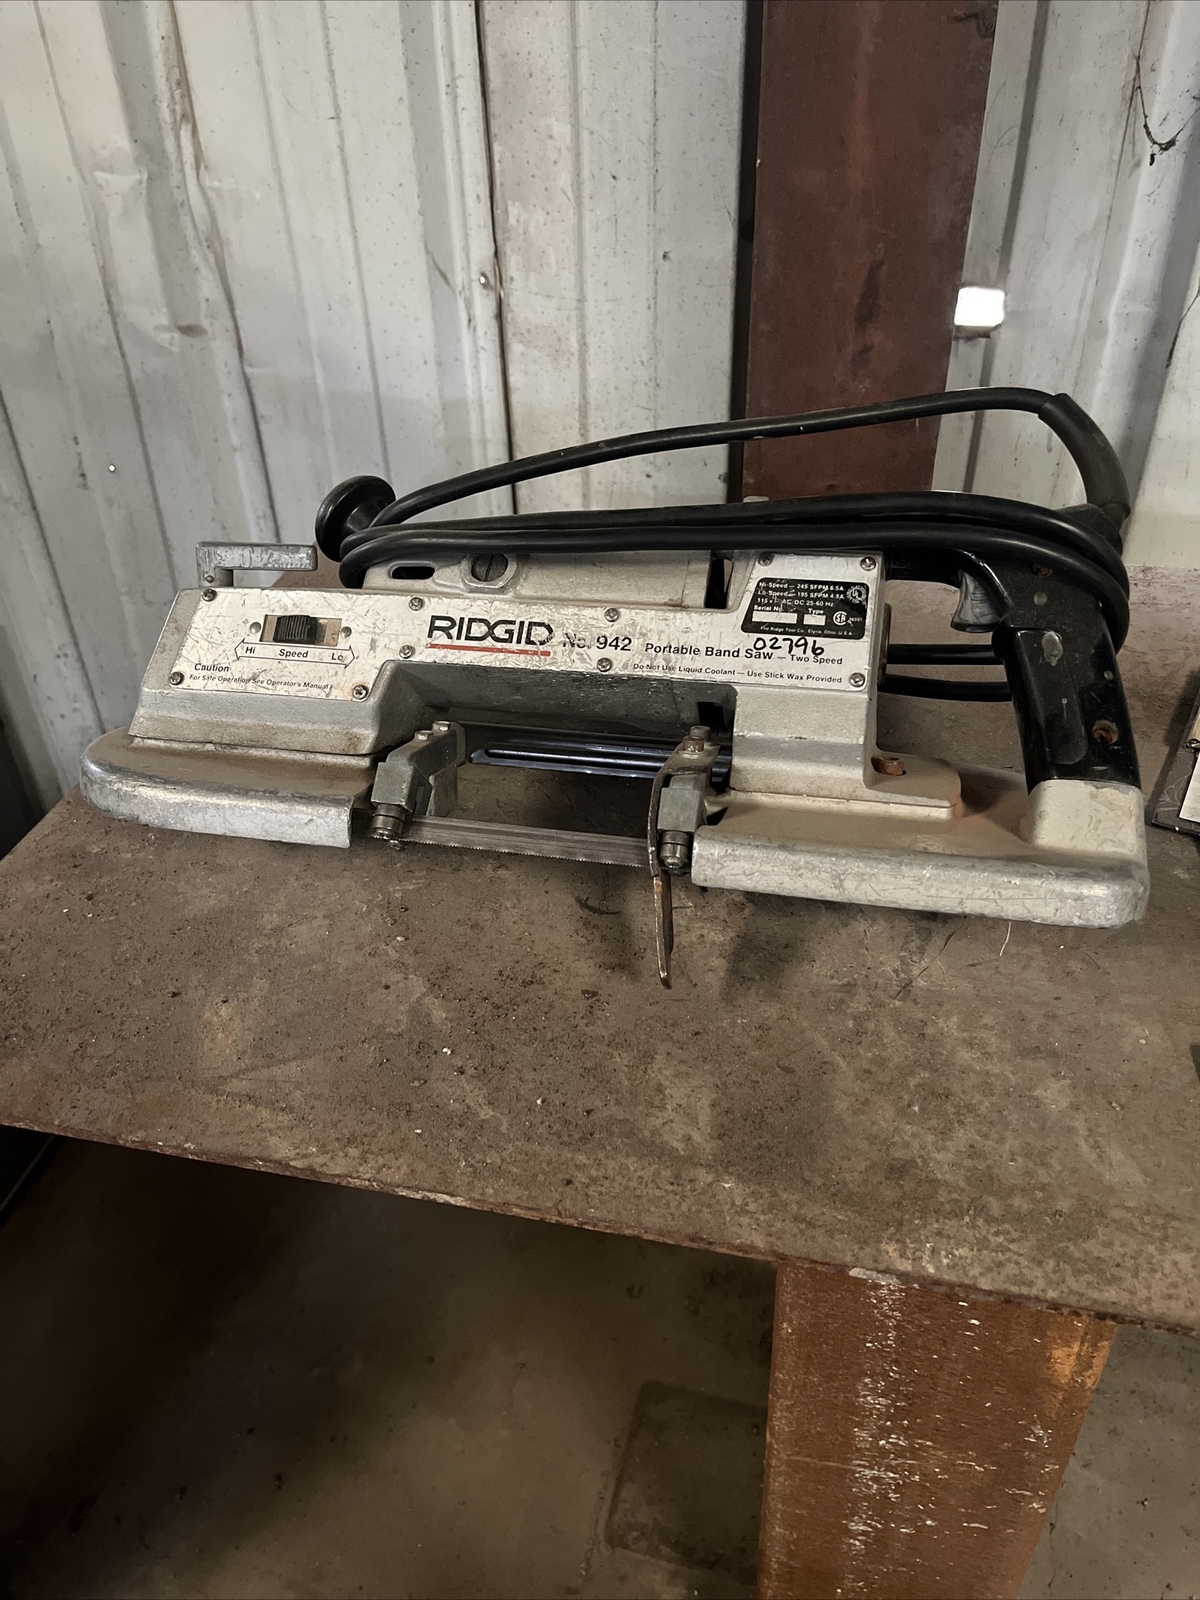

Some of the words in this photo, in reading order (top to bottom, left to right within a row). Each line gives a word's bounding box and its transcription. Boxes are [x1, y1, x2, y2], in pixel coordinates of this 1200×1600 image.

[427, 615, 554, 646] RIDGID
[597, 636, 632, 651] 942
[753, 637, 825, 656] 02796
[278, 649, 309, 659] Speed
[331, 653, 344, 661] Lo
[645, 643, 700, 656] Portable
[705, 647, 740, 658] Band
[744, 648, 773, 660] Saw
[790, 654, 810, 663] Two
[813, 655, 843, 665] Speed
[194, 664, 230, 672] Caution
[678, 666, 703, 674] Liquid
[704, 667, 736, 676] Coolant
[747, 670, 763, 678] Use
[764, 671, 785, 679] Stick
[806, 674, 843, 684] Provided
